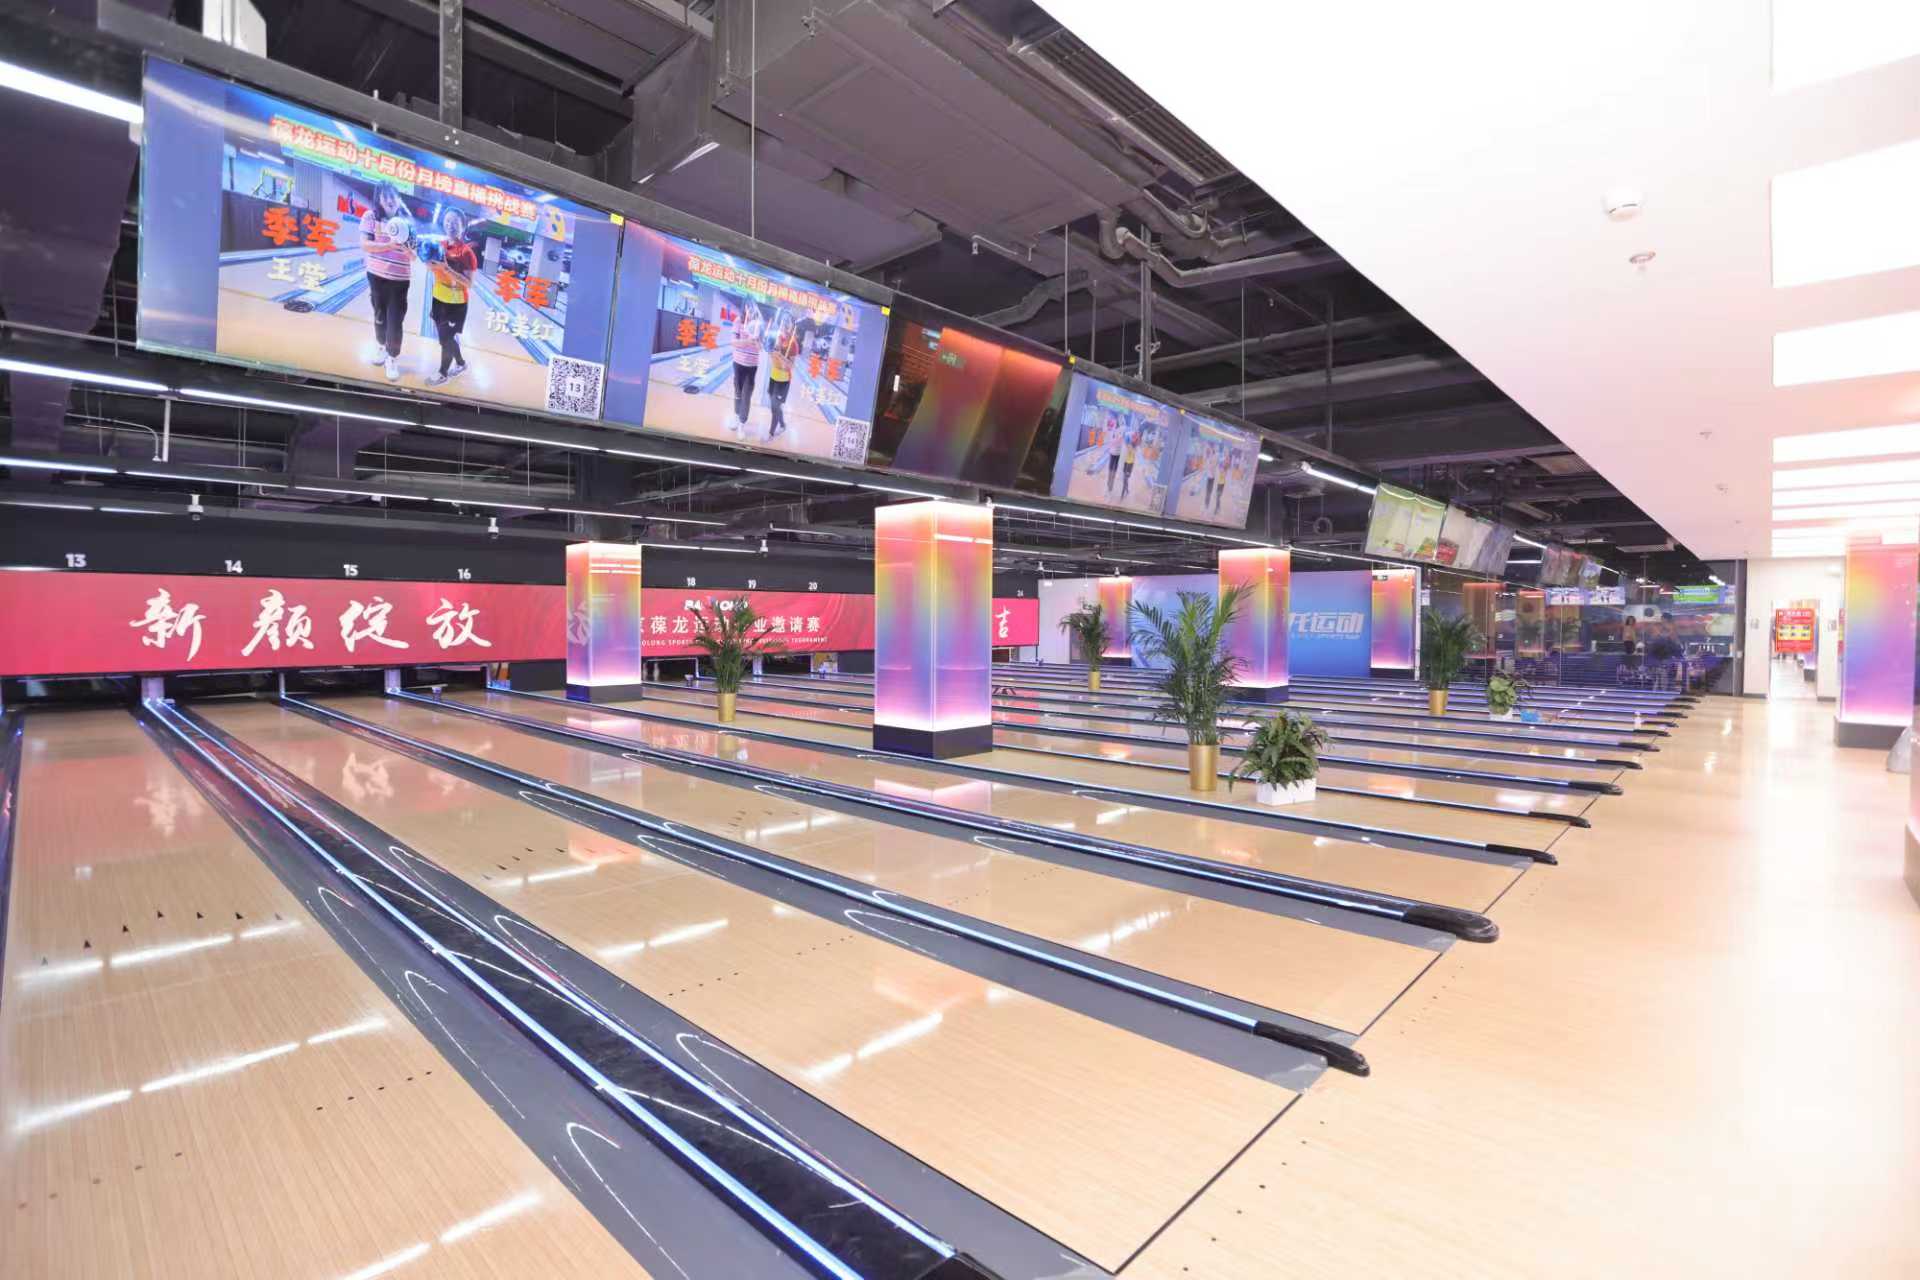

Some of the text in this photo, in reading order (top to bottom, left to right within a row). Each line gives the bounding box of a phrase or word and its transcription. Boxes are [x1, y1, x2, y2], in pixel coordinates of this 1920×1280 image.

[262, 207, 340, 256] 季军
[494, 269, 550, 310] 季军
[568, 381, 582, 393] 13
[65, 553, 87, 568] 13
[225, 560, 243, 574] 14
[343, 564, 359, 577] 15
[457, 568, 472, 580] 16
[686, 577, 697, 588] 18
[748, 579, 757, 590] 19
[808, 582, 818, 591] 20
[129, 587, 493, 662] 新颜绽放
